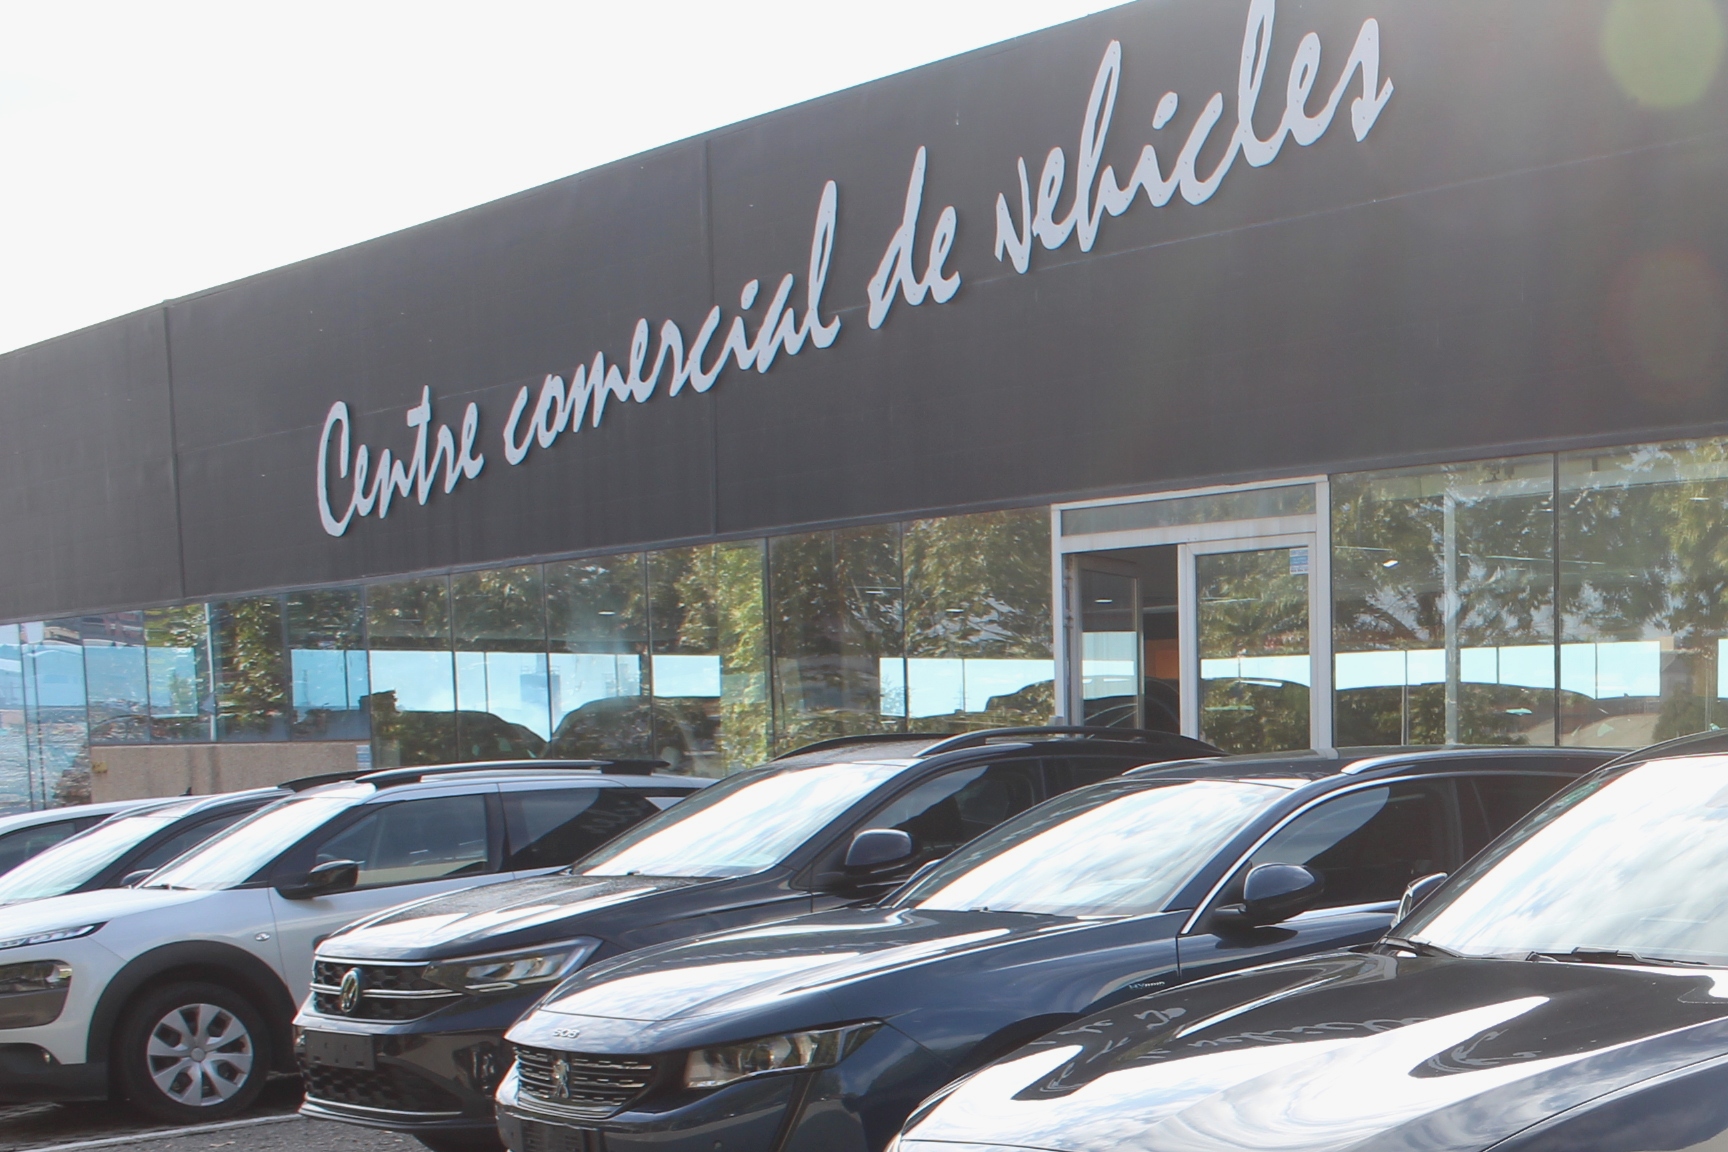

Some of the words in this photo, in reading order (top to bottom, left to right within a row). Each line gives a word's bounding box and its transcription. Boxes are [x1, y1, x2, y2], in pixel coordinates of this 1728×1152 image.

[316, 384, 485, 538] Centre
[502, 179, 841, 466] comercial
[867, 145, 962, 330] de
[994, 0, 1395, 275] vehicles
